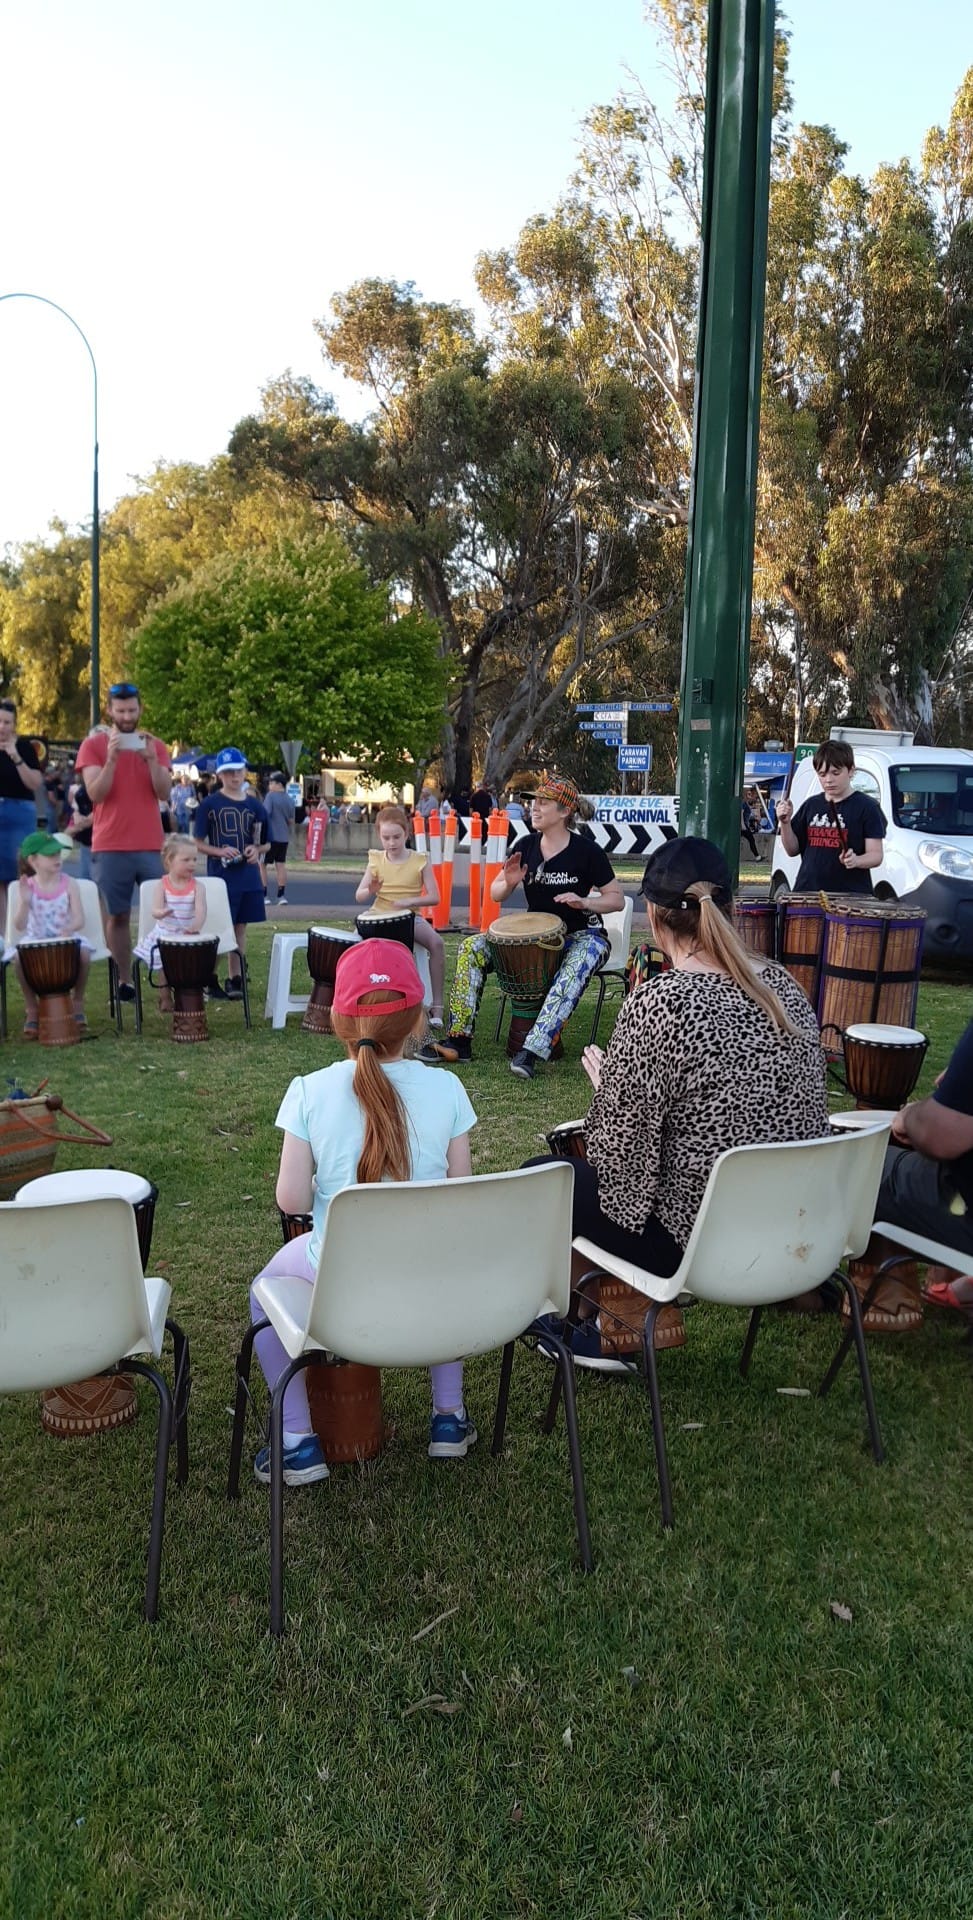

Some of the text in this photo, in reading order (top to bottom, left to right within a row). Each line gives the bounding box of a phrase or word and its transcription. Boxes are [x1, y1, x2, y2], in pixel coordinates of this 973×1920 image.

[620, 748, 648, 756] CARAVAN
[621, 757, 646, 765] PARKING
[598, 797, 637, 808] YEARS
[614, 810, 671, 823] CARNIVAL
[808, 837, 841, 848] THINGS
